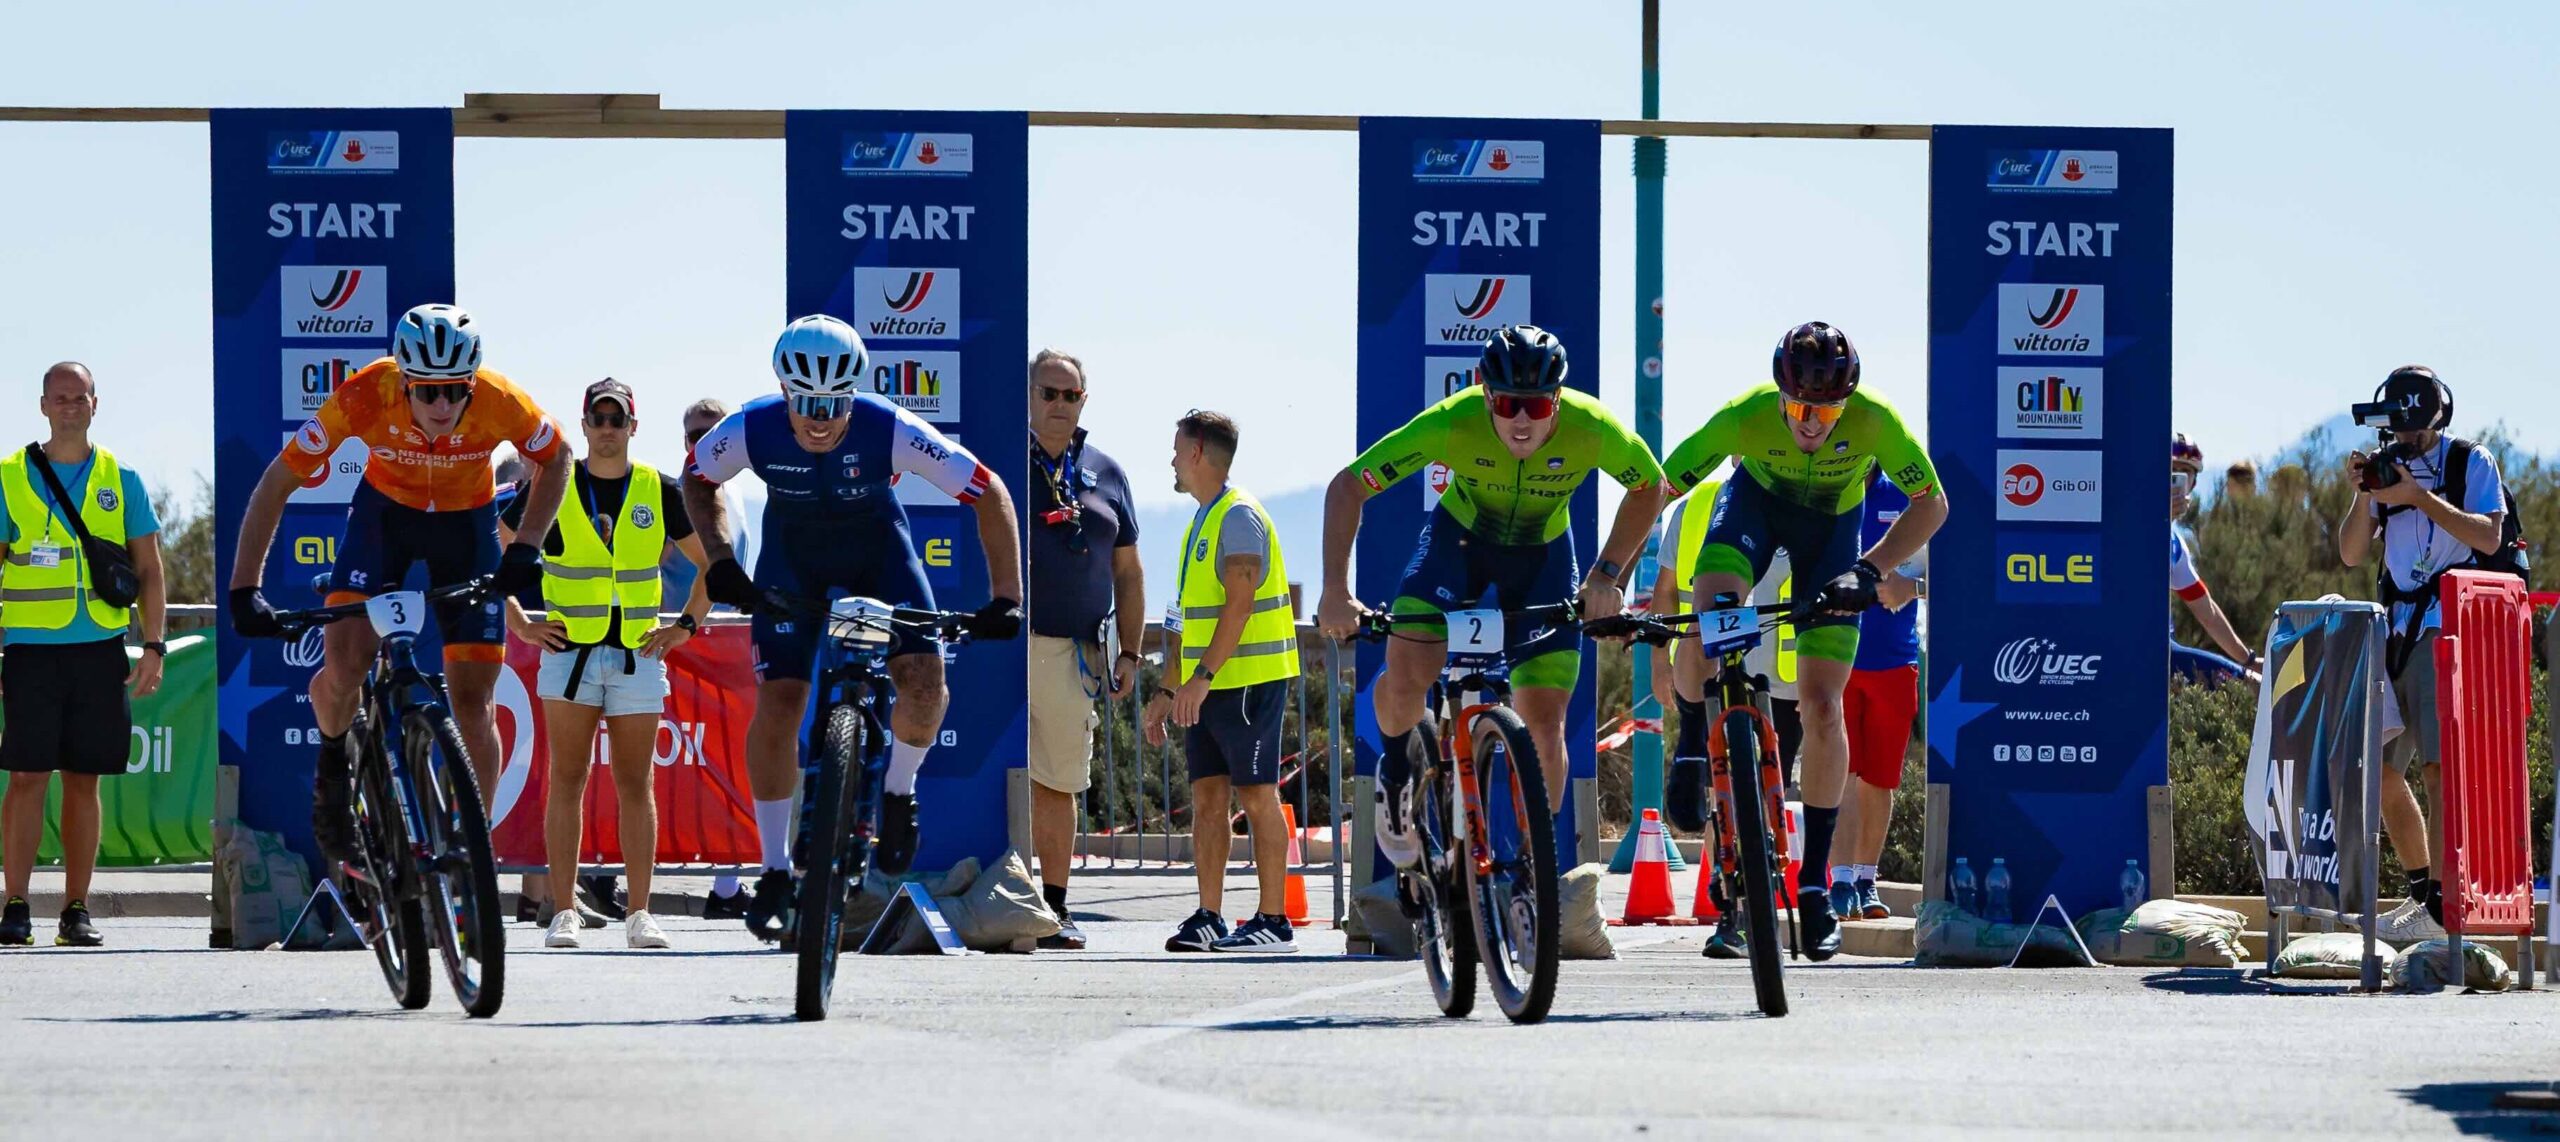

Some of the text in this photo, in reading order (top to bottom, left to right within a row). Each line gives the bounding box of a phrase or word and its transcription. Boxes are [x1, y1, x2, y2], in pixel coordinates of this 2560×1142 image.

[2010, 163, 2032, 173] UEC
[267, 202, 402, 238] START
[841, 203, 975, 240] START
[1412, 211, 1547, 247] START
[1986, 220, 2119, 257] START
[297, 315, 374, 334] vittoria
[870, 316, 946, 336] vittoria
[1441, 323, 1507, 341] vittor
[2014, 333, 2091, 352] vittoria
[874, 361, 940, 395] CITY
[2017, 377, 2082, 412] CITY
[2017, 413, 2082, 424] MOUNTAINBIKE
[910, 436, 950, 462] SKF
[339, 462, 362, 474] Gib
[766, 464, 813, 473] GIANT
[1895, 461, 1920, 480] TRI
[1902, 470, 1925, 488] MO
[2003, 475, 2039, 496] GO
[2052, 480, 2096, 493] Gib Oil
[390, 601, 406, 625] 3
[856, 606, 866, 632] 1
[1469, 617, 1482, 645] 2
[1717, 614, 1741, 634] 12
[2042, 654, 2102, 675] UEC
[2005, 709, 2090, 721] www.uec.ch
